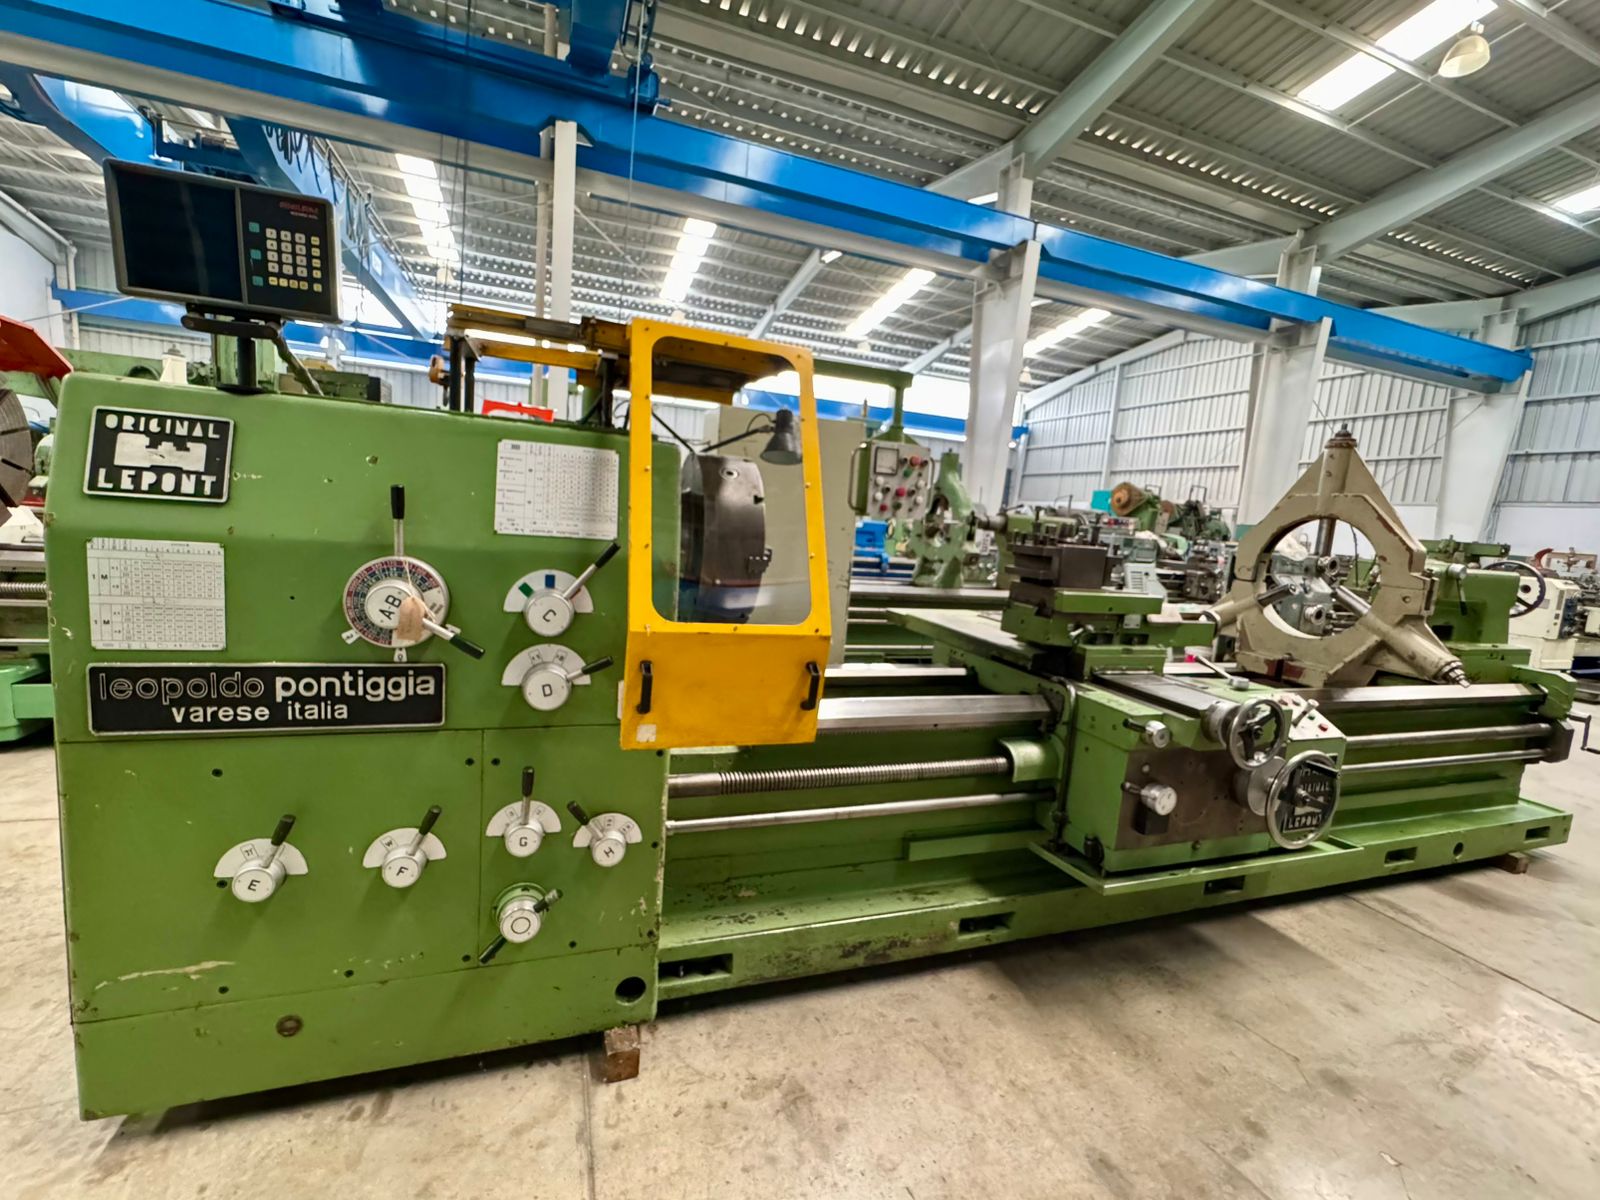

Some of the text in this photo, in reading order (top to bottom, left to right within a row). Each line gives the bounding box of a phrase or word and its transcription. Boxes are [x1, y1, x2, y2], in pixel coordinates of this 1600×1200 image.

[105, 413, 220, 439] ORIGINAL
[97, 467, 217, 496] LEPONT
[542, 608, 557, 623] C
[99, 670, 436, 705] leopoldo pontiggia
[542, 683, 553, 698] D
[171, 701, 348, 723] varese italia
[519, 836, 528, 847] G
[603, 847, 615, 859] H
[396, 866, 409, 877] F
[247, 879, 261, 892] E
